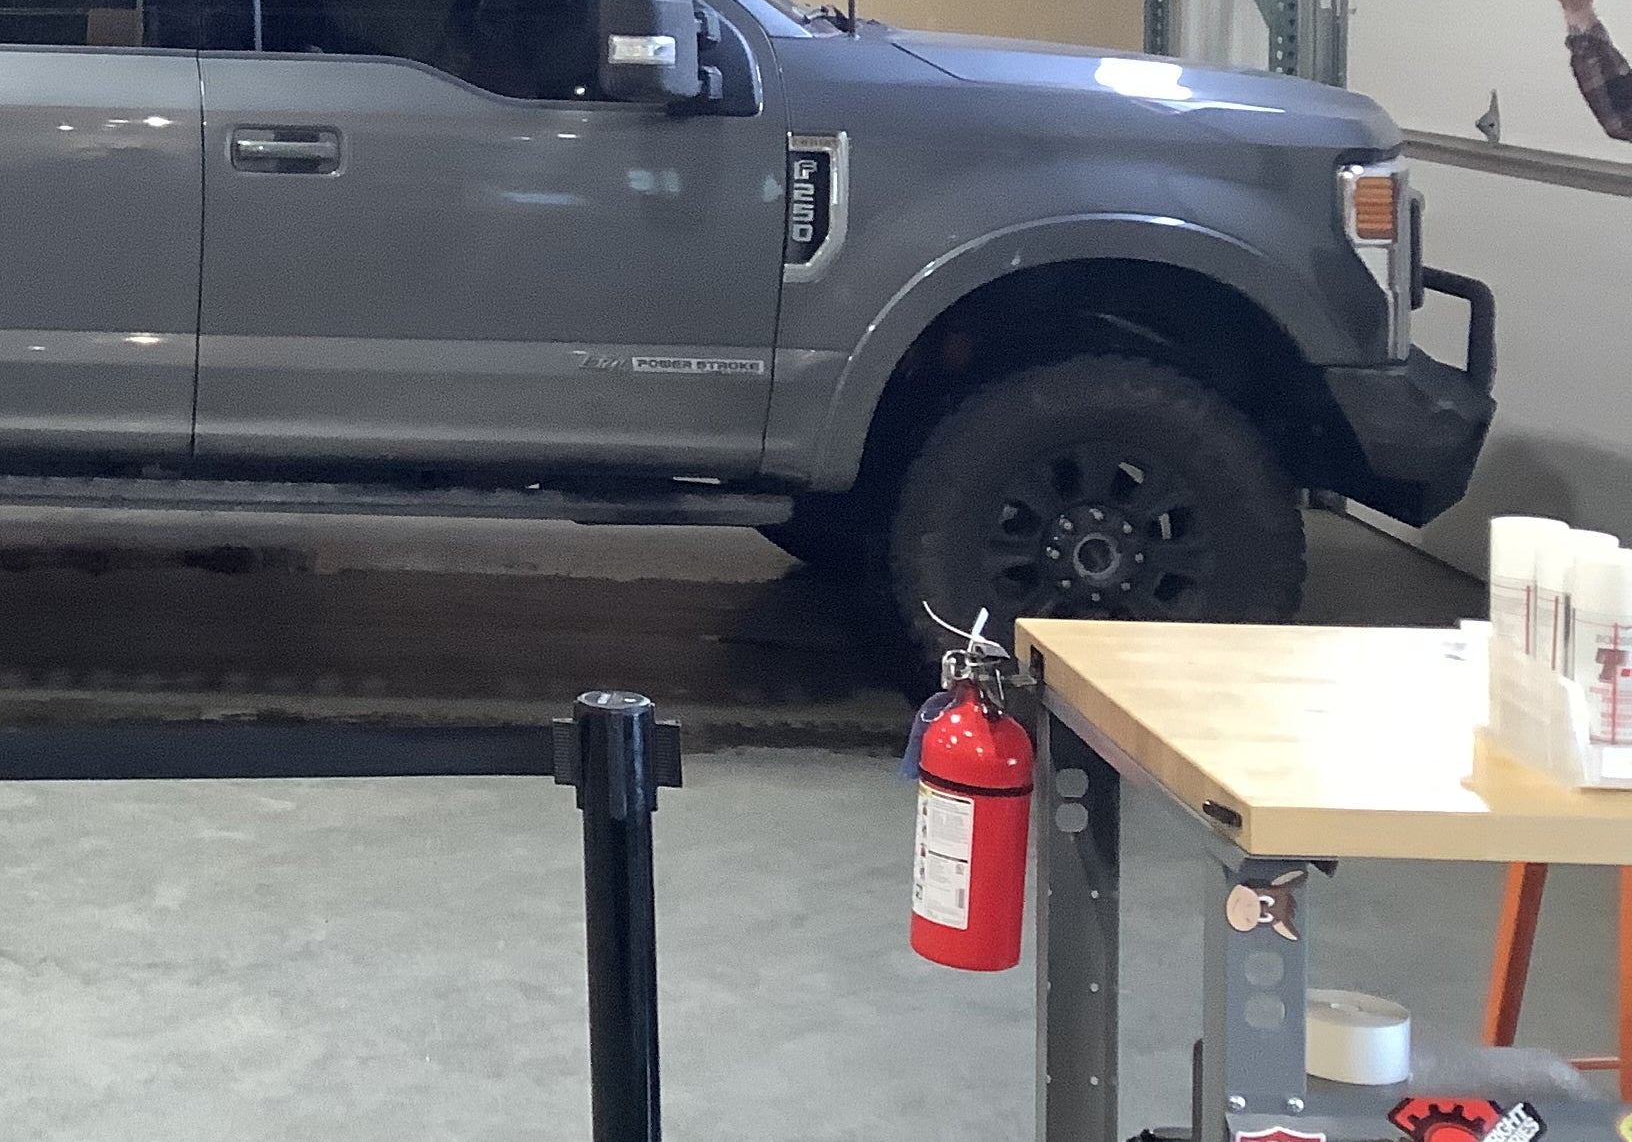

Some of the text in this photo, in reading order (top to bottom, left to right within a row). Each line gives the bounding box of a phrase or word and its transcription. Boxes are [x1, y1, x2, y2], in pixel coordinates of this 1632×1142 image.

[792, 159, 818, 243] F250
[636, 359, 693, 370] POWER
[696, 360, 760, 371] STROKE
[1483, 1102, 1528, 1142] RIGHT
